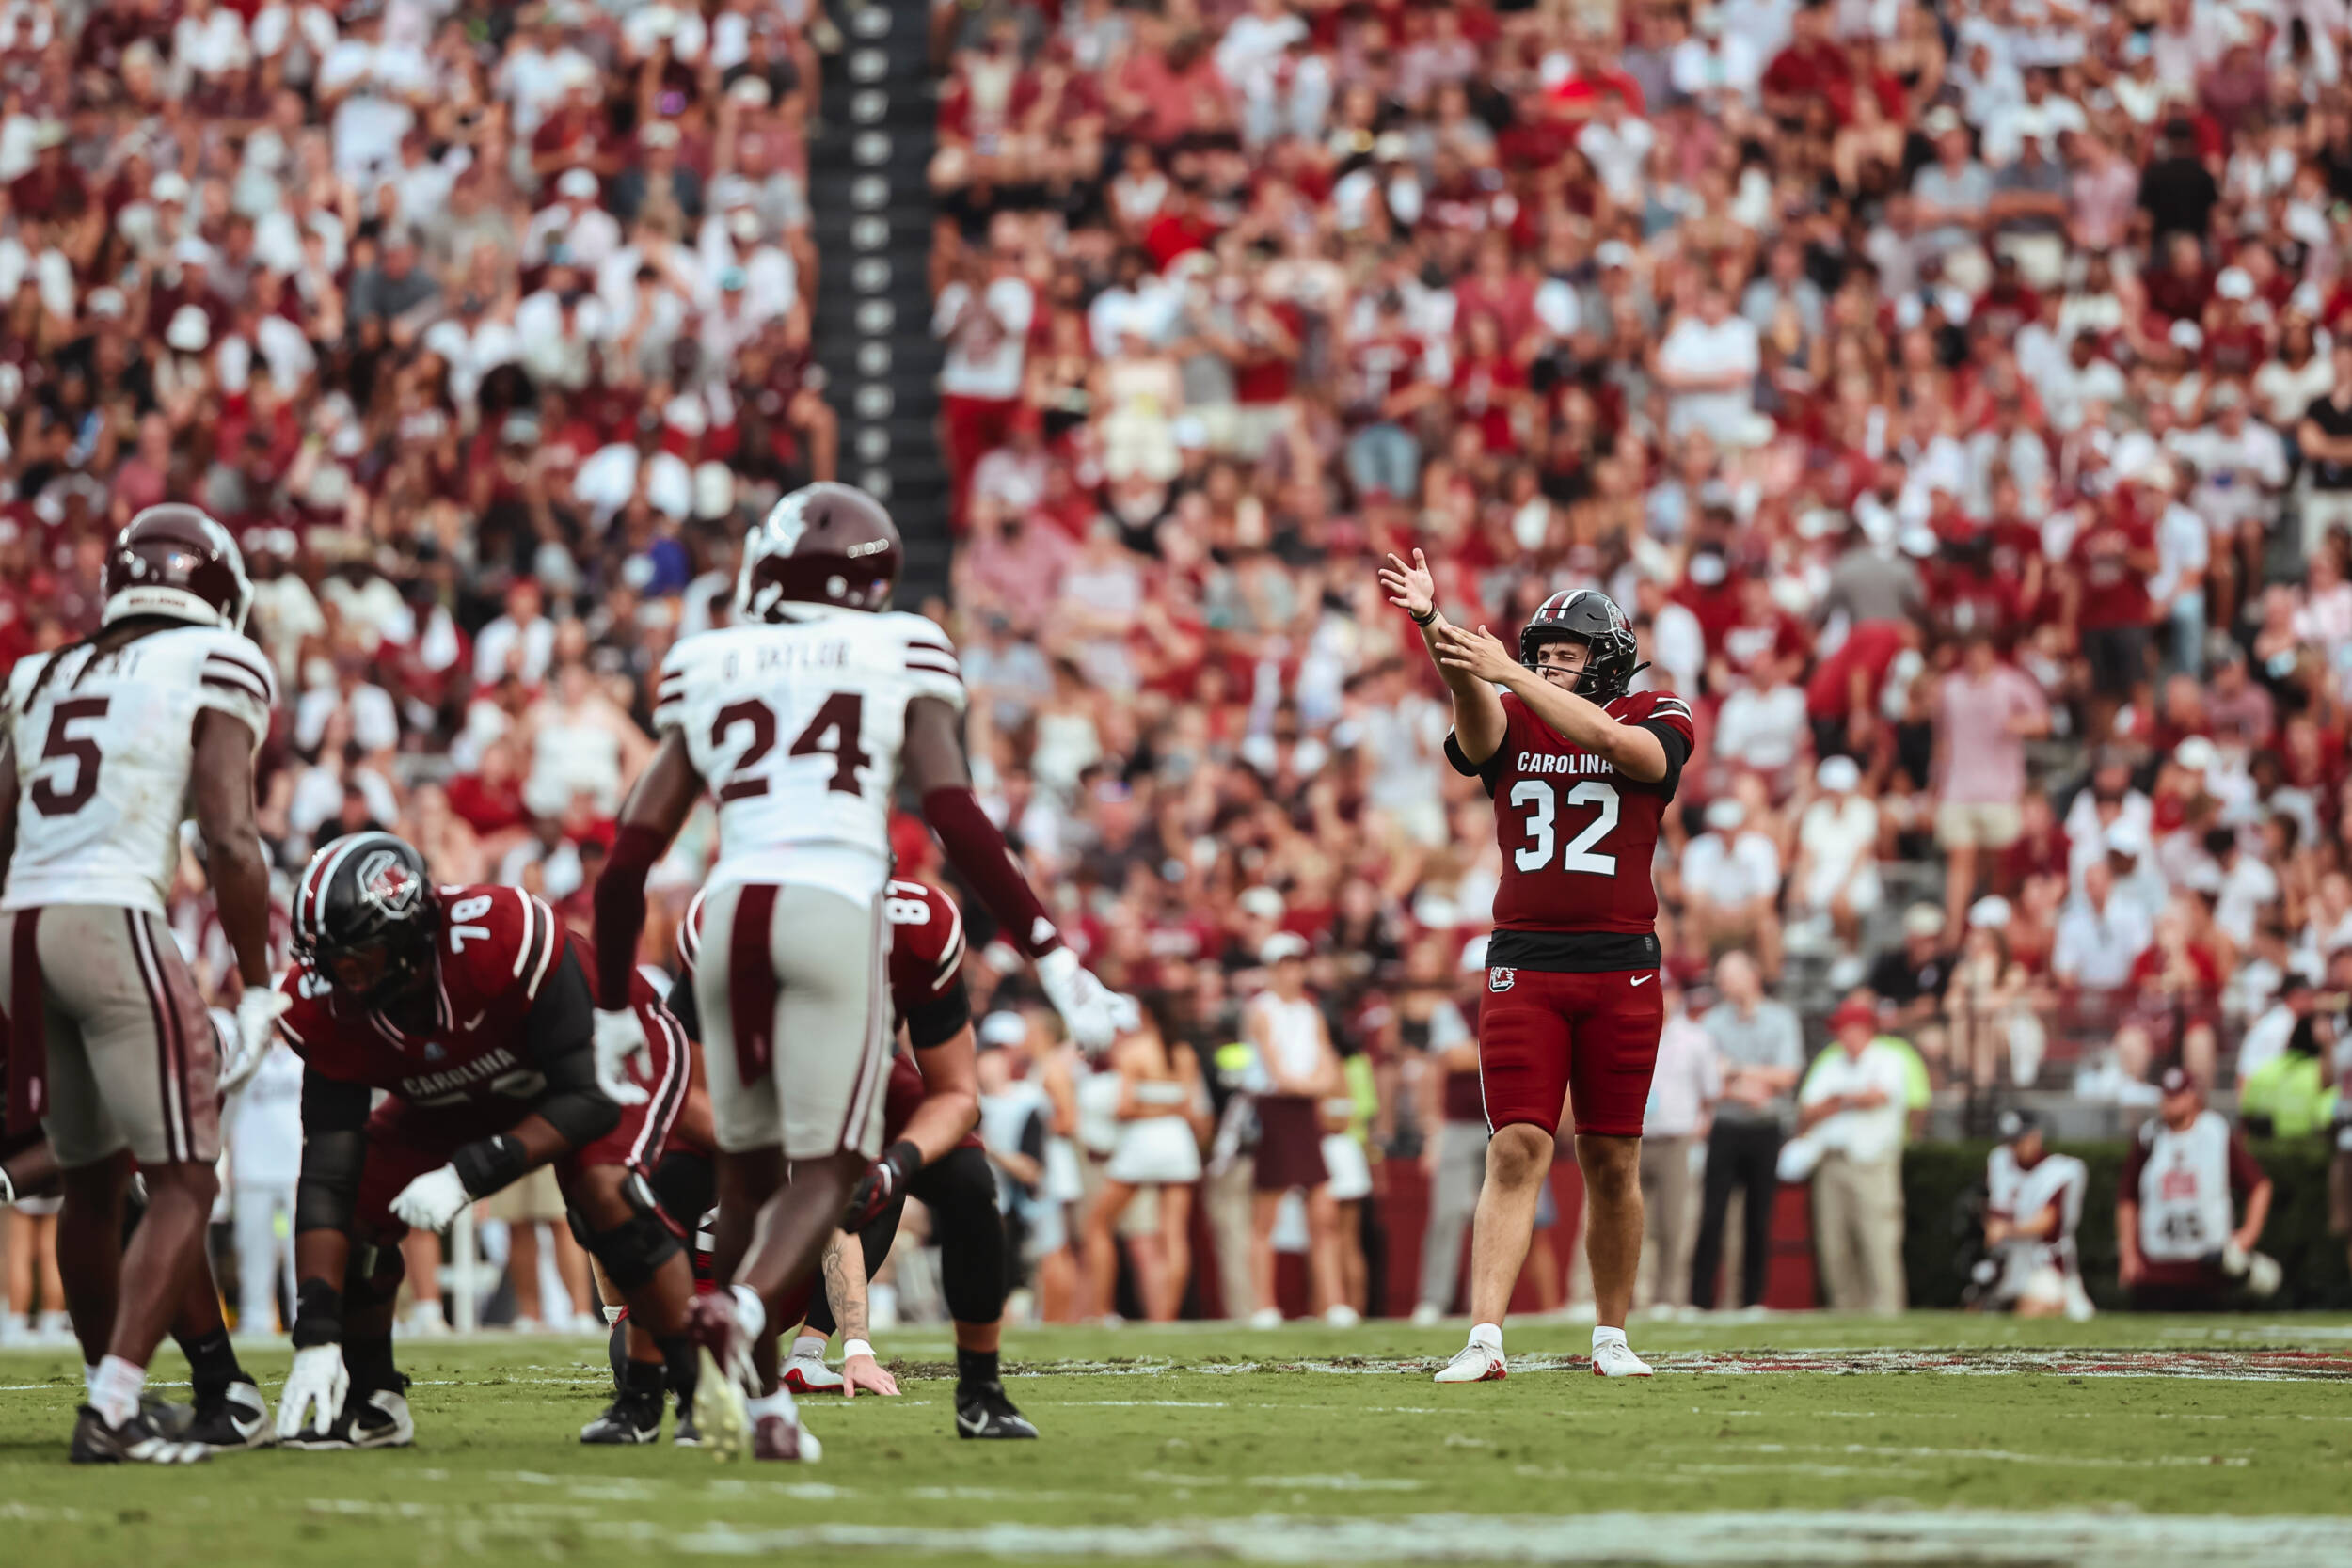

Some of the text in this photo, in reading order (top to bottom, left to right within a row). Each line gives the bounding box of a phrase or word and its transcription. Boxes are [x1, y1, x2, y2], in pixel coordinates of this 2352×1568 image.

[31, 697, 110, 817] 5
[711, 692, 871, 801] 24
[1517, 752, 1613, 774] CAROLINA
[1510, 780, 1619, 876] 32
[450, 895, 492, 954] 78
[885, 879, 930, 926] 87
[402, 1048, 516, 1095] CAROLINA
